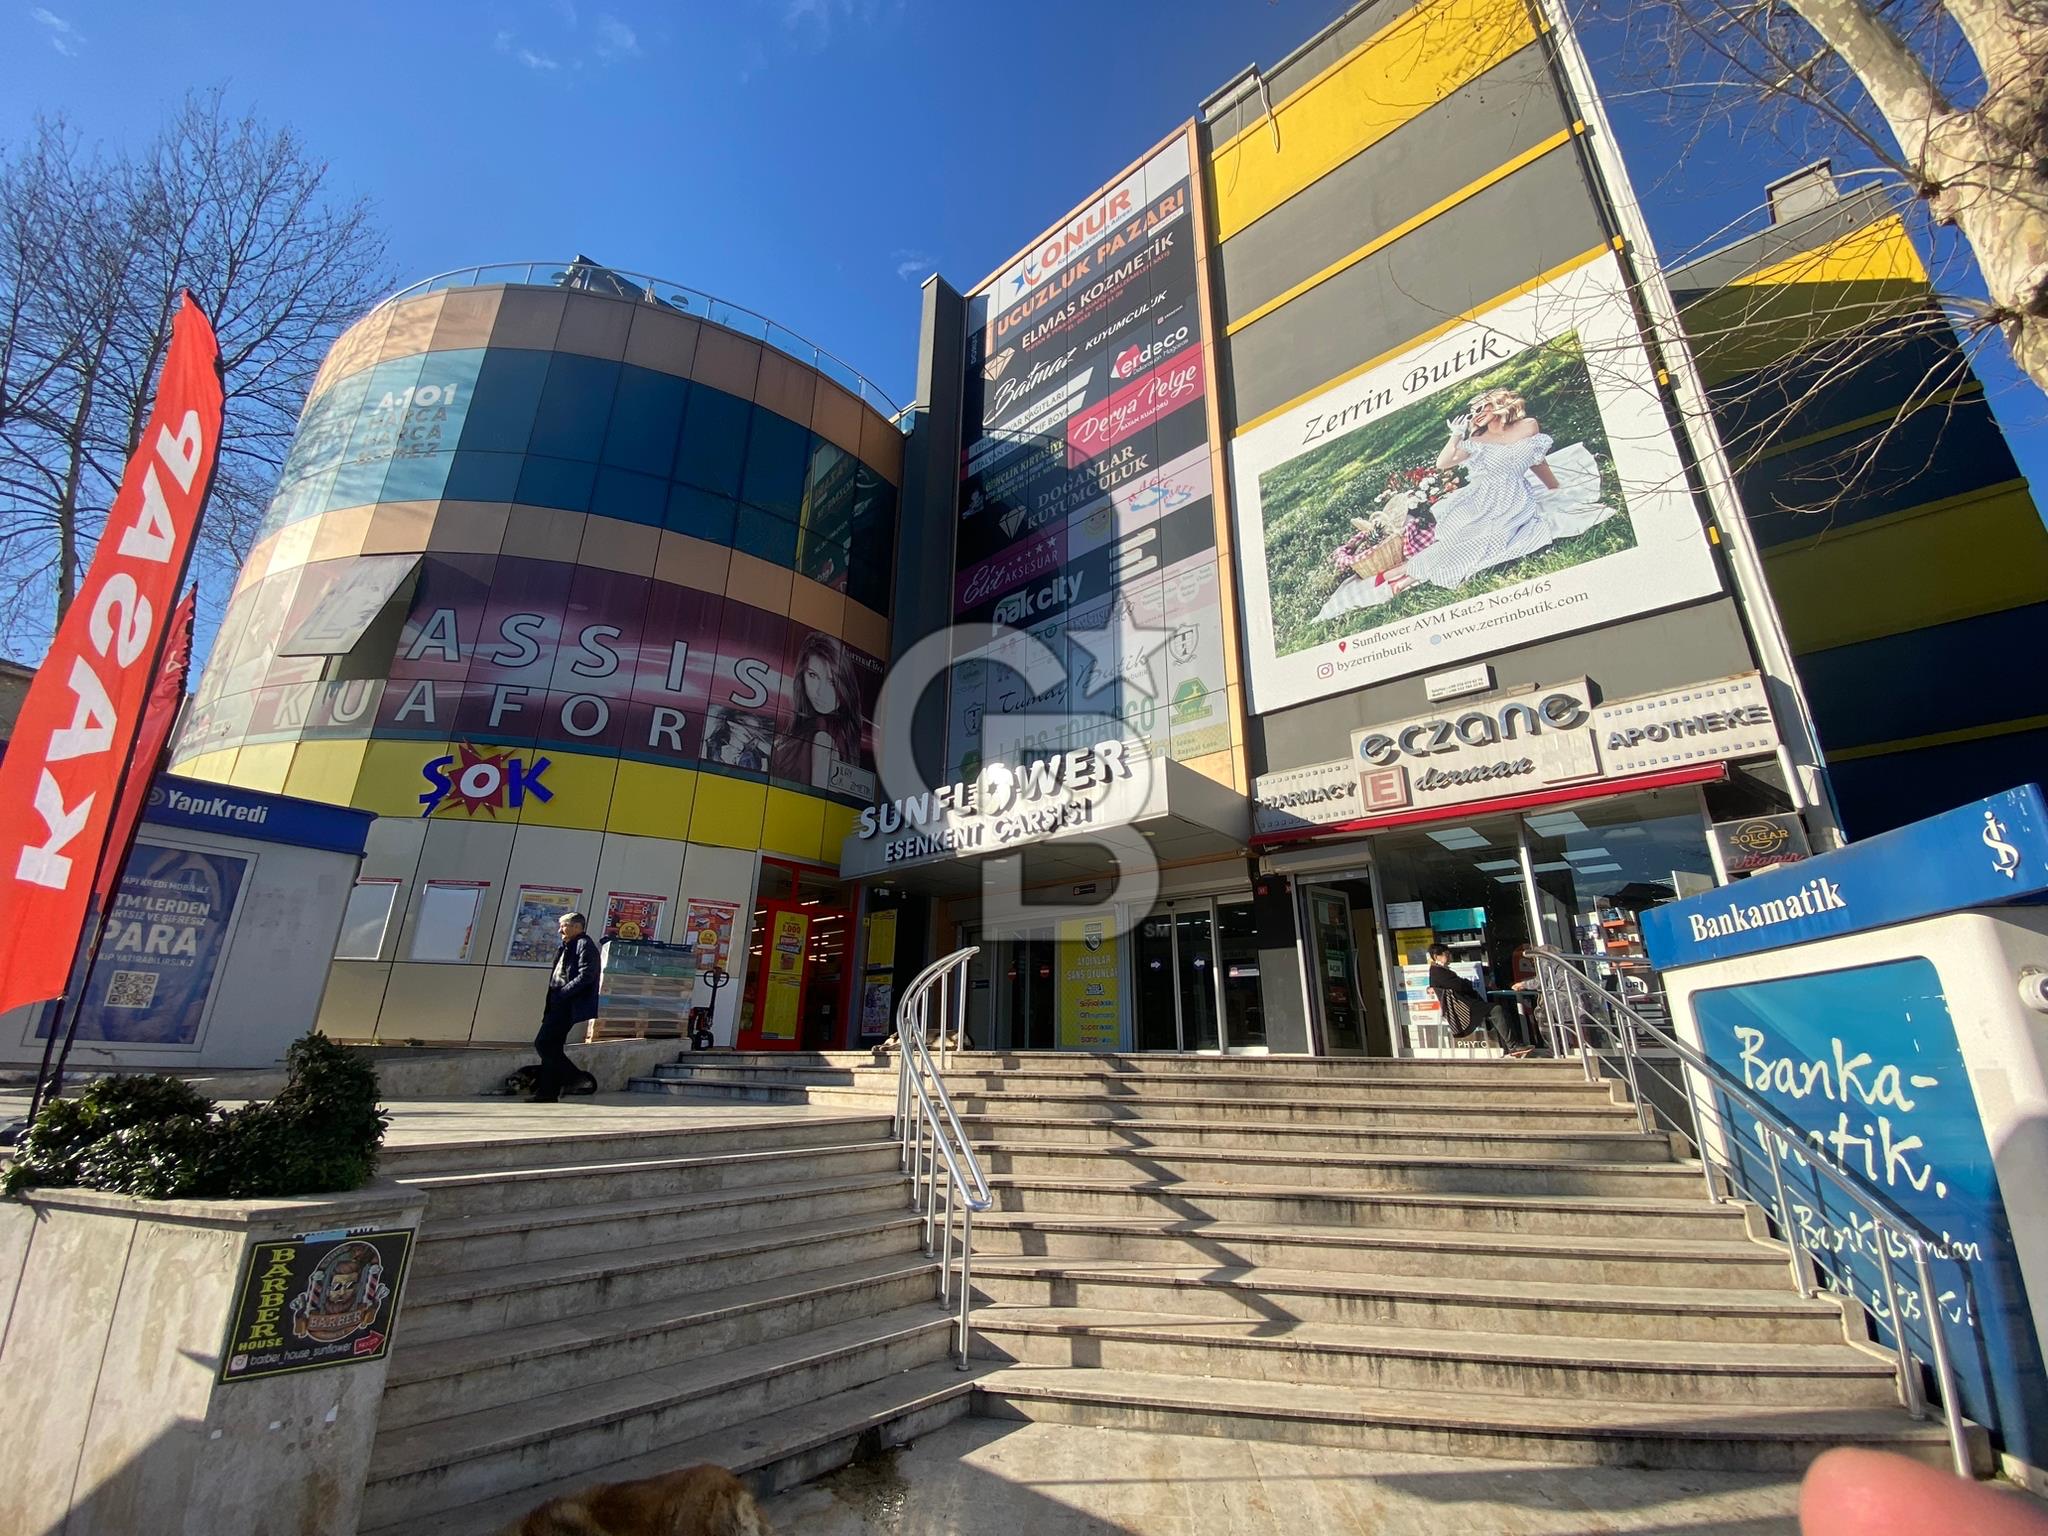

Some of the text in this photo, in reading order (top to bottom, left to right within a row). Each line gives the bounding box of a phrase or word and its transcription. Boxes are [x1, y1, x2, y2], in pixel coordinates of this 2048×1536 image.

[1041, 188, 1132, 269] ONUR
[997, 255, 1091, 336] UCUZLUK
[1097, 187, 1184, 265] PAZARI
[1022, 301, 1076, 349] ELMAS
[1080, 231, 1174, 308] KOZMETİK
[1085, 289, 1168, 350] KUYUMCULUK
[1074, 365, 1196, 443] Derya Pelge
[1302, 328, 1511, 446] Zerrin Butik
[1028, 454, 1149, 529] KUYUMCULUK
[1004, 550, 1058, 584] AKSESUAR
[1352, 581, 1553, 650] Sunflower AVM Kat:2 No:64/65
[1441, 590, 1590, 641] www.zerrinbutik.com
[1336, 640, 1413, 673] byzerrinbutik
[273, 677, 689, 753] KUAFOR
[1360, 692, 1772, 765] eczane APOTHEKE
[167, 789, 269, 824] YapıKredi
[419, 755, 554, 818] ŞOK
[857, 739, 1134, 840] SUNFLOWER
[1369, 772, 1398, 803] E
[1414, 756, 1535, 791] derman
[885, 822, 986, 863] ESENKENT
[1729, 827, 1790, 846] SOLGAR
[116, 892, 211, 917] TM'LERDEN
[147, 911, 160, 923] VE
[1688, 876, 1847, 944] Bankamatik
[101, 921, 198, 957] PARA
[1456, 1040, 1488, 1049] PHYTO
[1733, 1024, 1939, 1113] Banka-
[249, 1247, 295, 1340] BARBER
[238, 1337, 284, 1352] HOUSE
